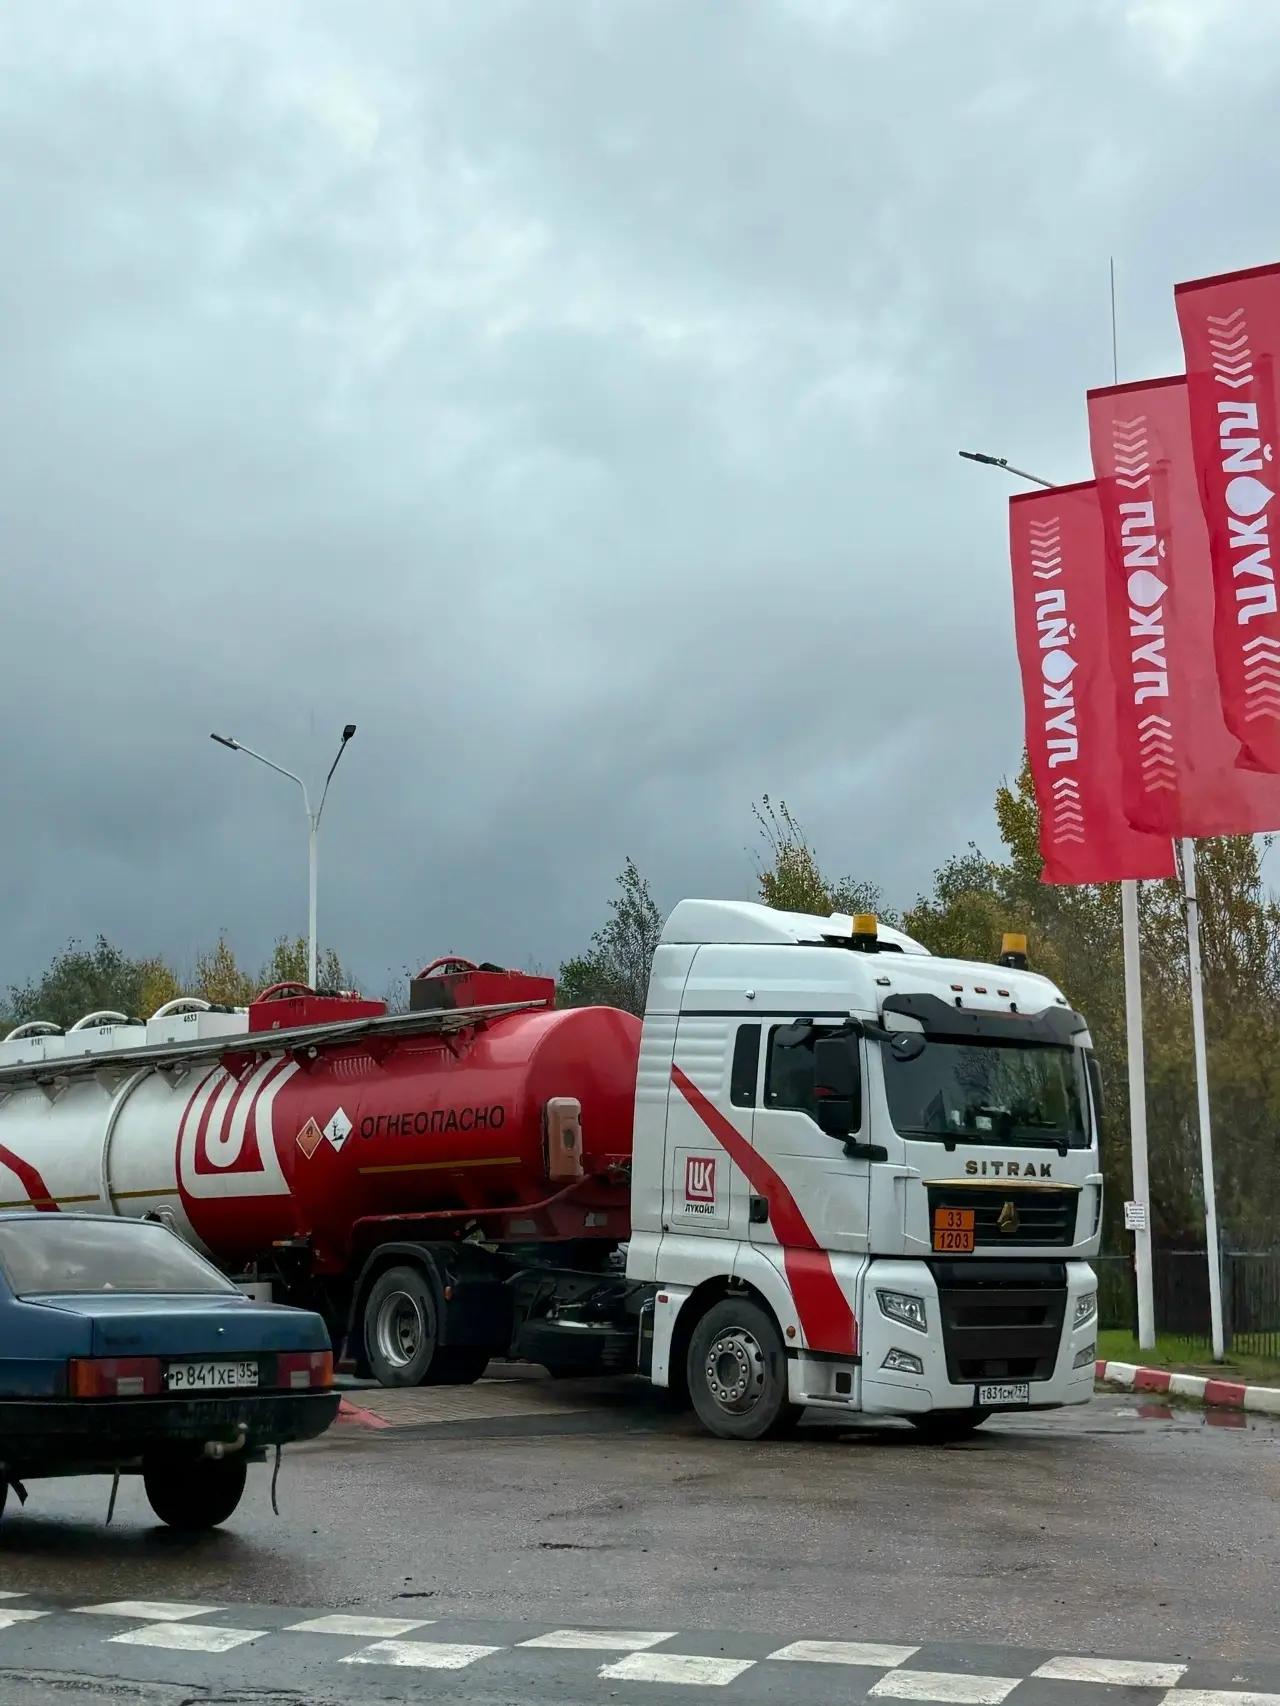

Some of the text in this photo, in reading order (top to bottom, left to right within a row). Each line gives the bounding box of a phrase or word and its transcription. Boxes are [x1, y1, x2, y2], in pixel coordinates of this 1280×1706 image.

[360, 1105, 505, 1140] ОГНЕОПАСНО
[965, 1160, 1052, 1178] SITRAK
[684, 1203, 715, 1214] ЛУКОЙЛ
[947, 1211, 962, 1228] 33
[940, 1232, 969, 1249] 1203
